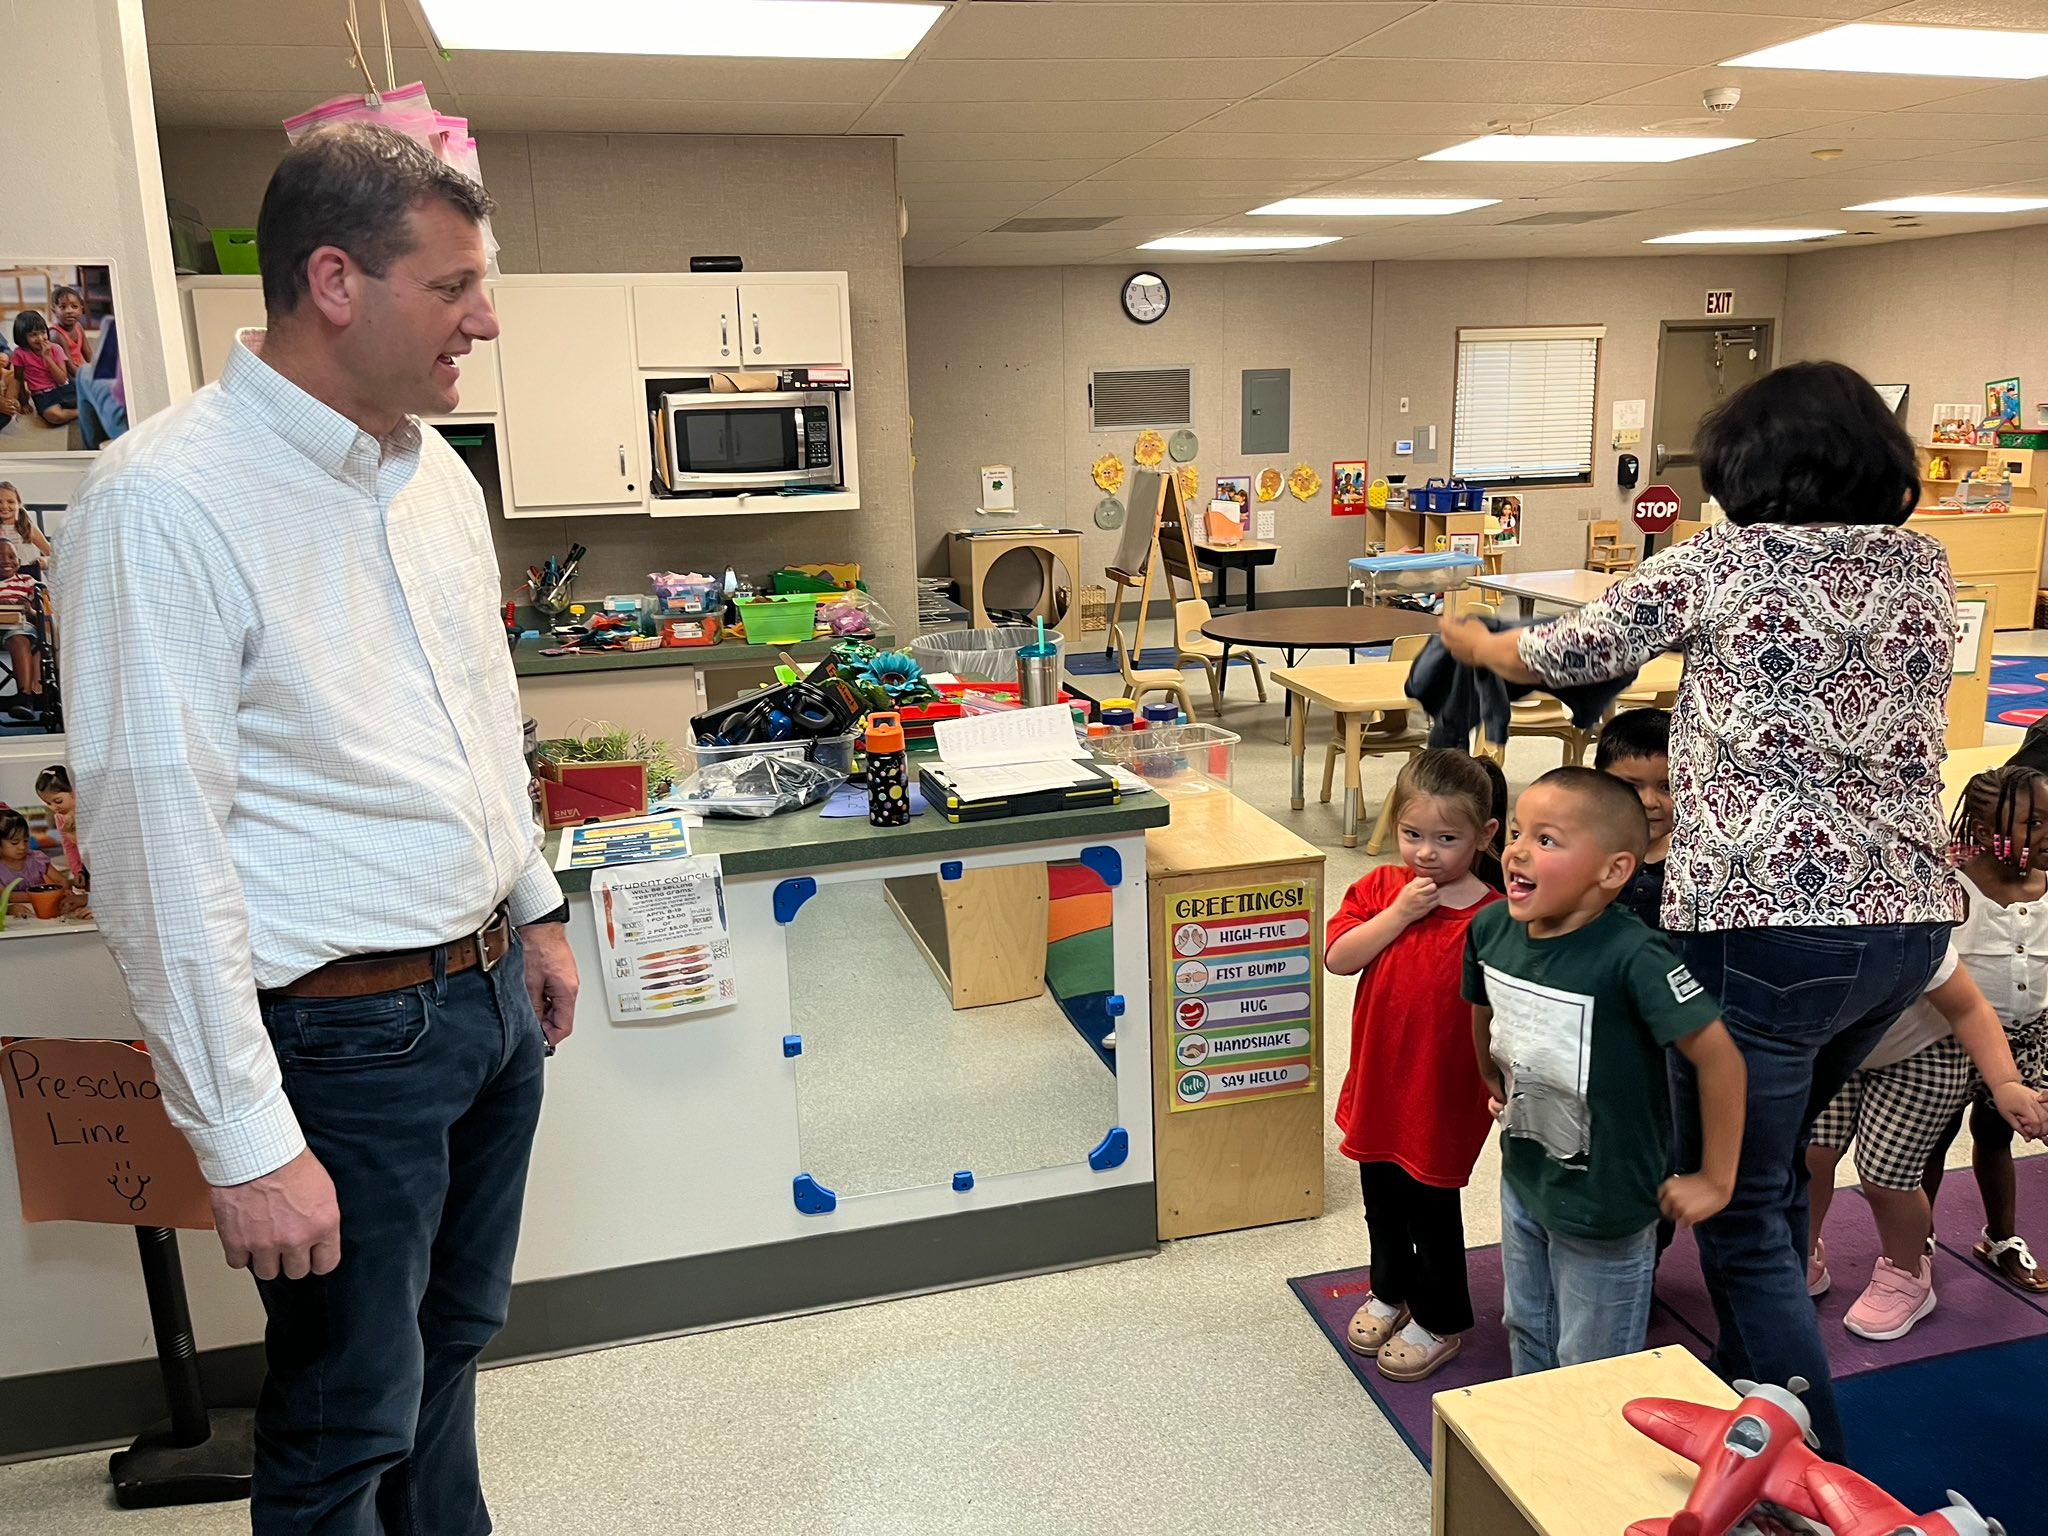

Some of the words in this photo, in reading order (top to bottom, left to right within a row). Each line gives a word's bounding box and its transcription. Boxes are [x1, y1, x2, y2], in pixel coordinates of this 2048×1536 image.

[1707, 292, 1732, 313] EXIT
[1636, 501, 1678, 518] STOP
[554, 807, 581, 817] VANS
[1176, 887, 1304, 918] GREETINGS!
[1220, 924, 1286, 943] HIGH-FIVE
[1216, 966, 1242, 980] FIST
[1248, 961, 1286, 977] BUMP
[1241, 999, 1267, 1013] HUG
[1214, 1033, 1291, 1052] HANDSHAKE
[1182, 1076, 1205, 1093] hello
[1222, 1073, 1244, 1087] SAY
[1250, 1068, 1288, 1084] HELLO
[47, 1112, 129, 1145] Line
